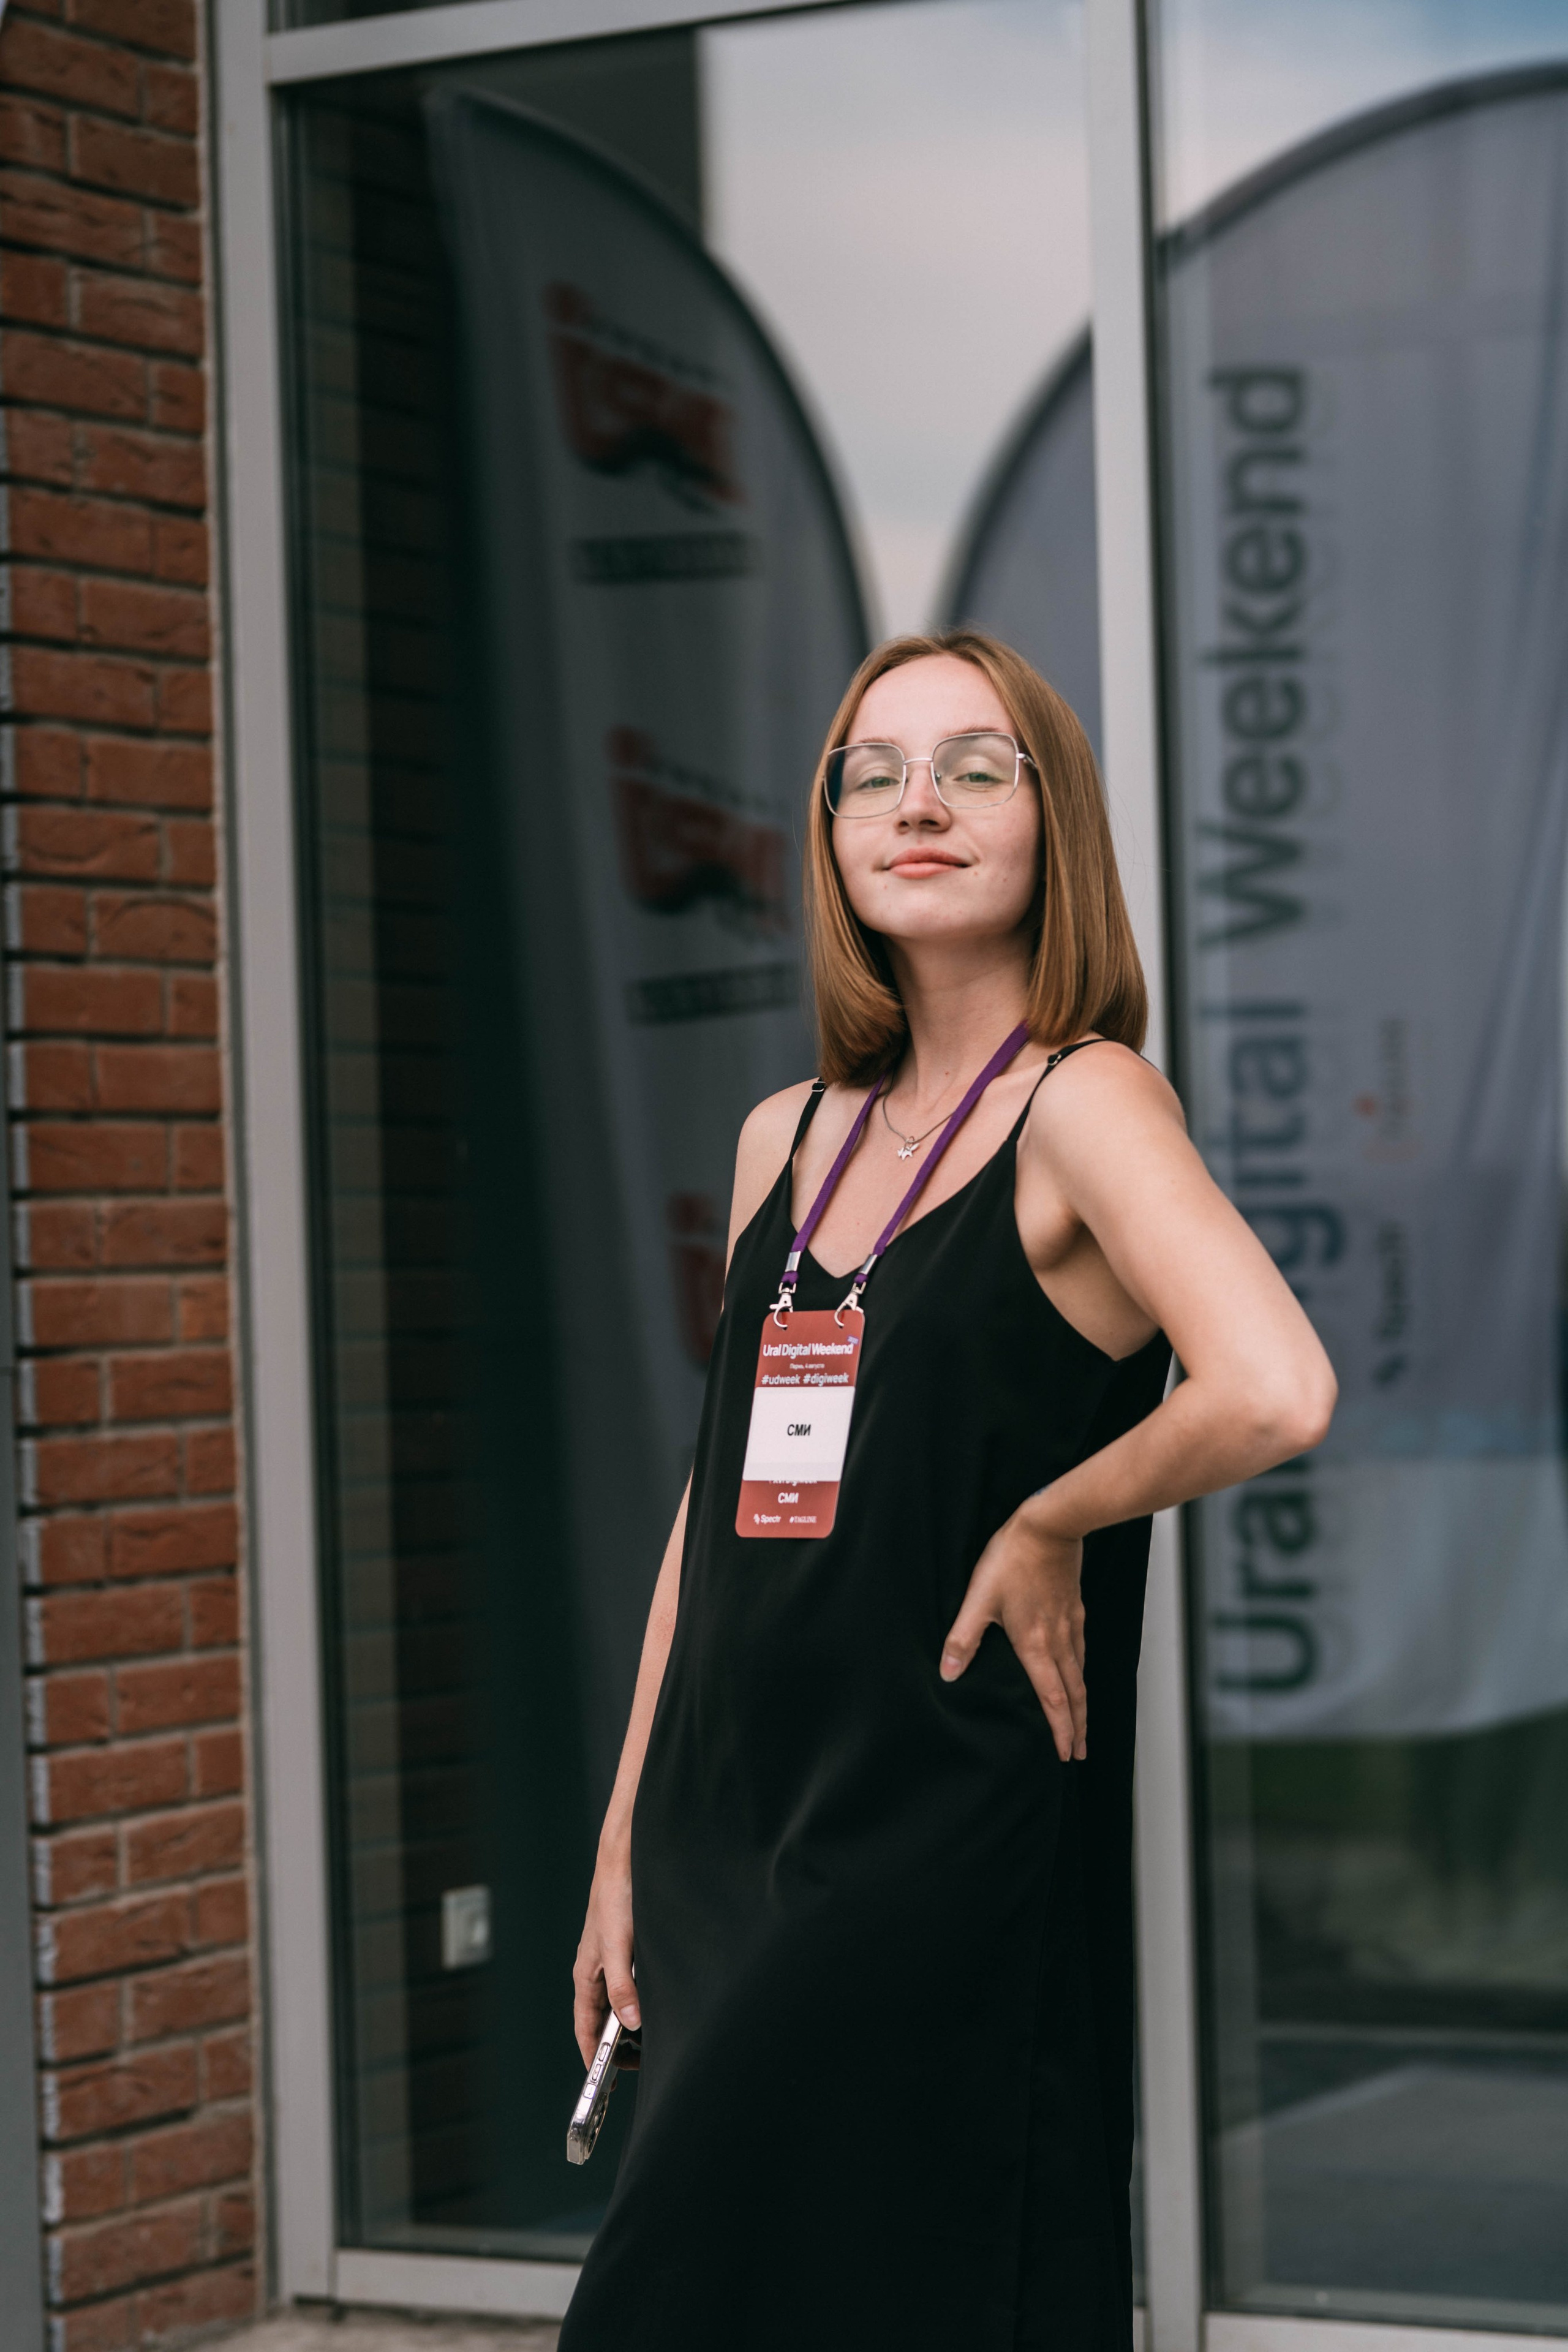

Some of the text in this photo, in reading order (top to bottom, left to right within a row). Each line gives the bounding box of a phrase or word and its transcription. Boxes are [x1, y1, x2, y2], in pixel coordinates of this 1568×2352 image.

[1196, 363, 1308, 954] Weekend
[763, 1342, 854, 1359] Ural Digital Weekend
[761, 1372, 849, 1386] #udweek #digiweek
[787, 1424, 811, 1436] СМИ
[777, 1492, 799, 1504] СМИ
[761, 1514, 782, 1523] Spectr
